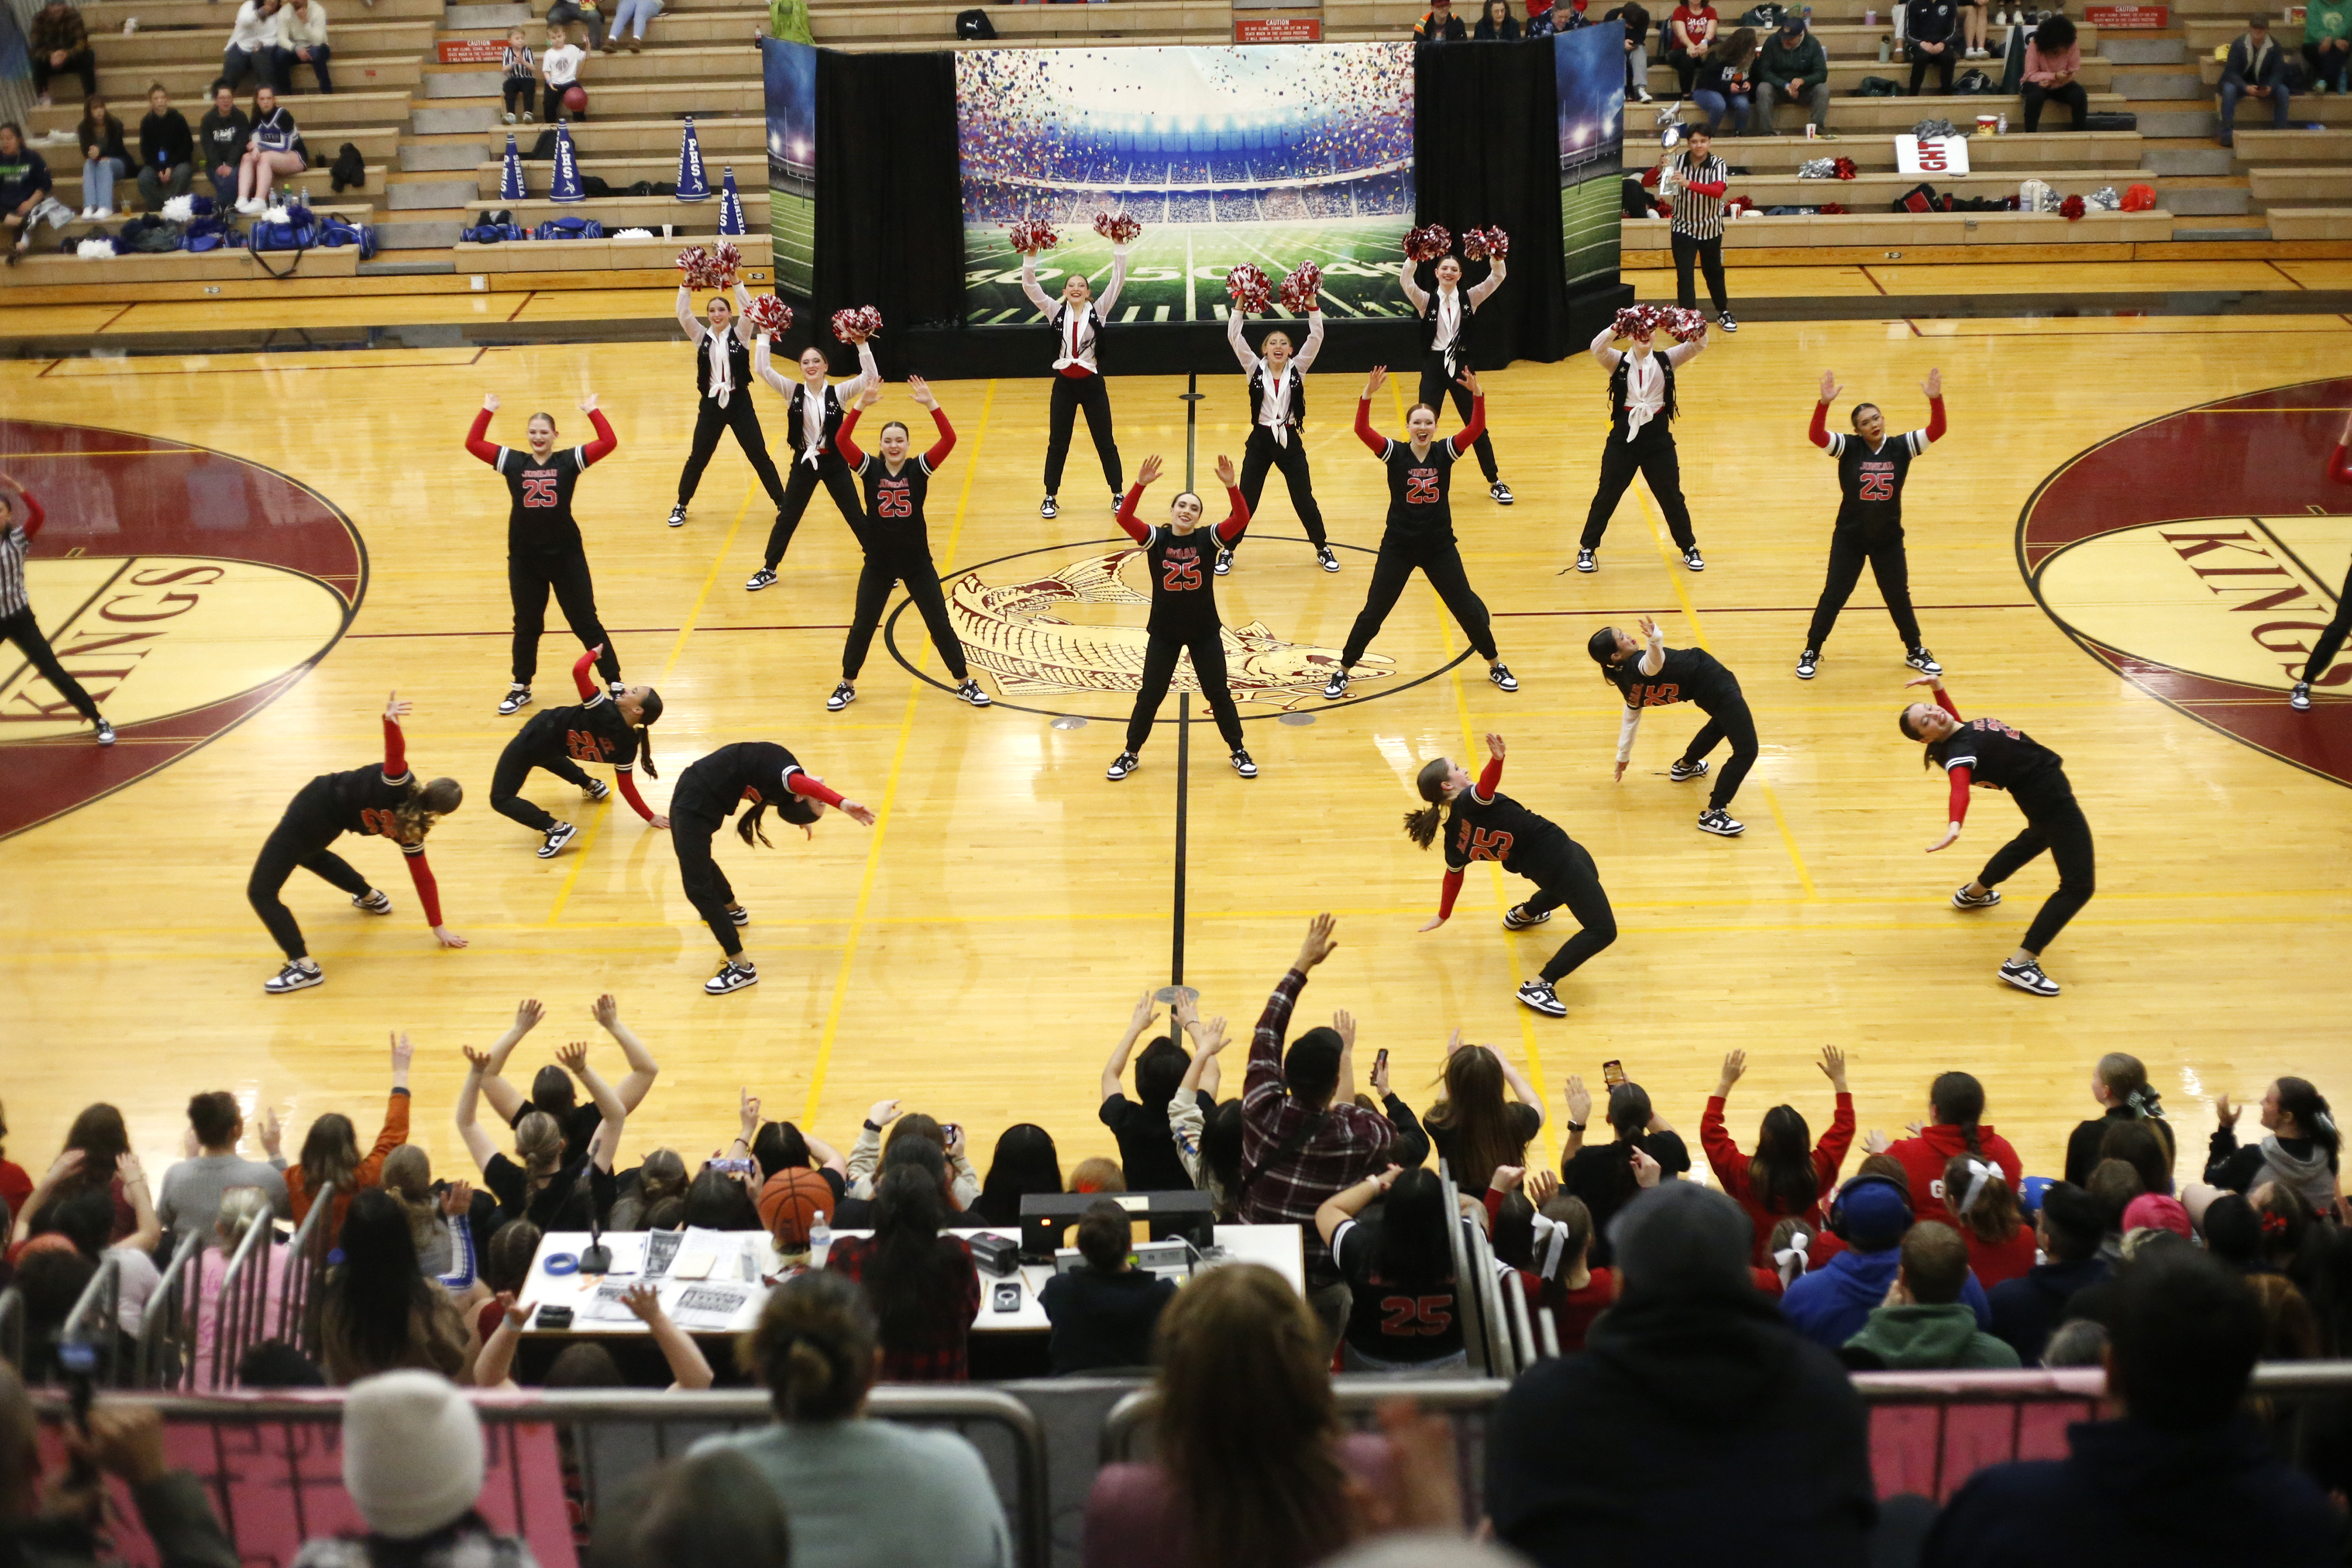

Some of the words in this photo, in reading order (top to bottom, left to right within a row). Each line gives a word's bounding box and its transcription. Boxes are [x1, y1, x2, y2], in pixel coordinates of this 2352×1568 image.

[500, 154, 510, 192] PHS
[560, 141, 573, 179] PHS
[688, 139, 701, 177] PHS
[1918, 141, 1949, 171] GHT
[513, 154, 526, 198] VIKINGS
[720, 189, 730, 227] PHS
[732, 192, 746, 236] VIKINGS
[523, 479, 557, 508] 25
[878, 489, 912, 517] 25
[1406, 476, 1439, 504] 25
[1860, 472, 1894, 501] 25
[1162, 556, 1202, 591] 25
[566, 729, 604, 763] 25
[1469, 827, 1514, 861] 25
[1380, 1294, 1454, 1336] 25
